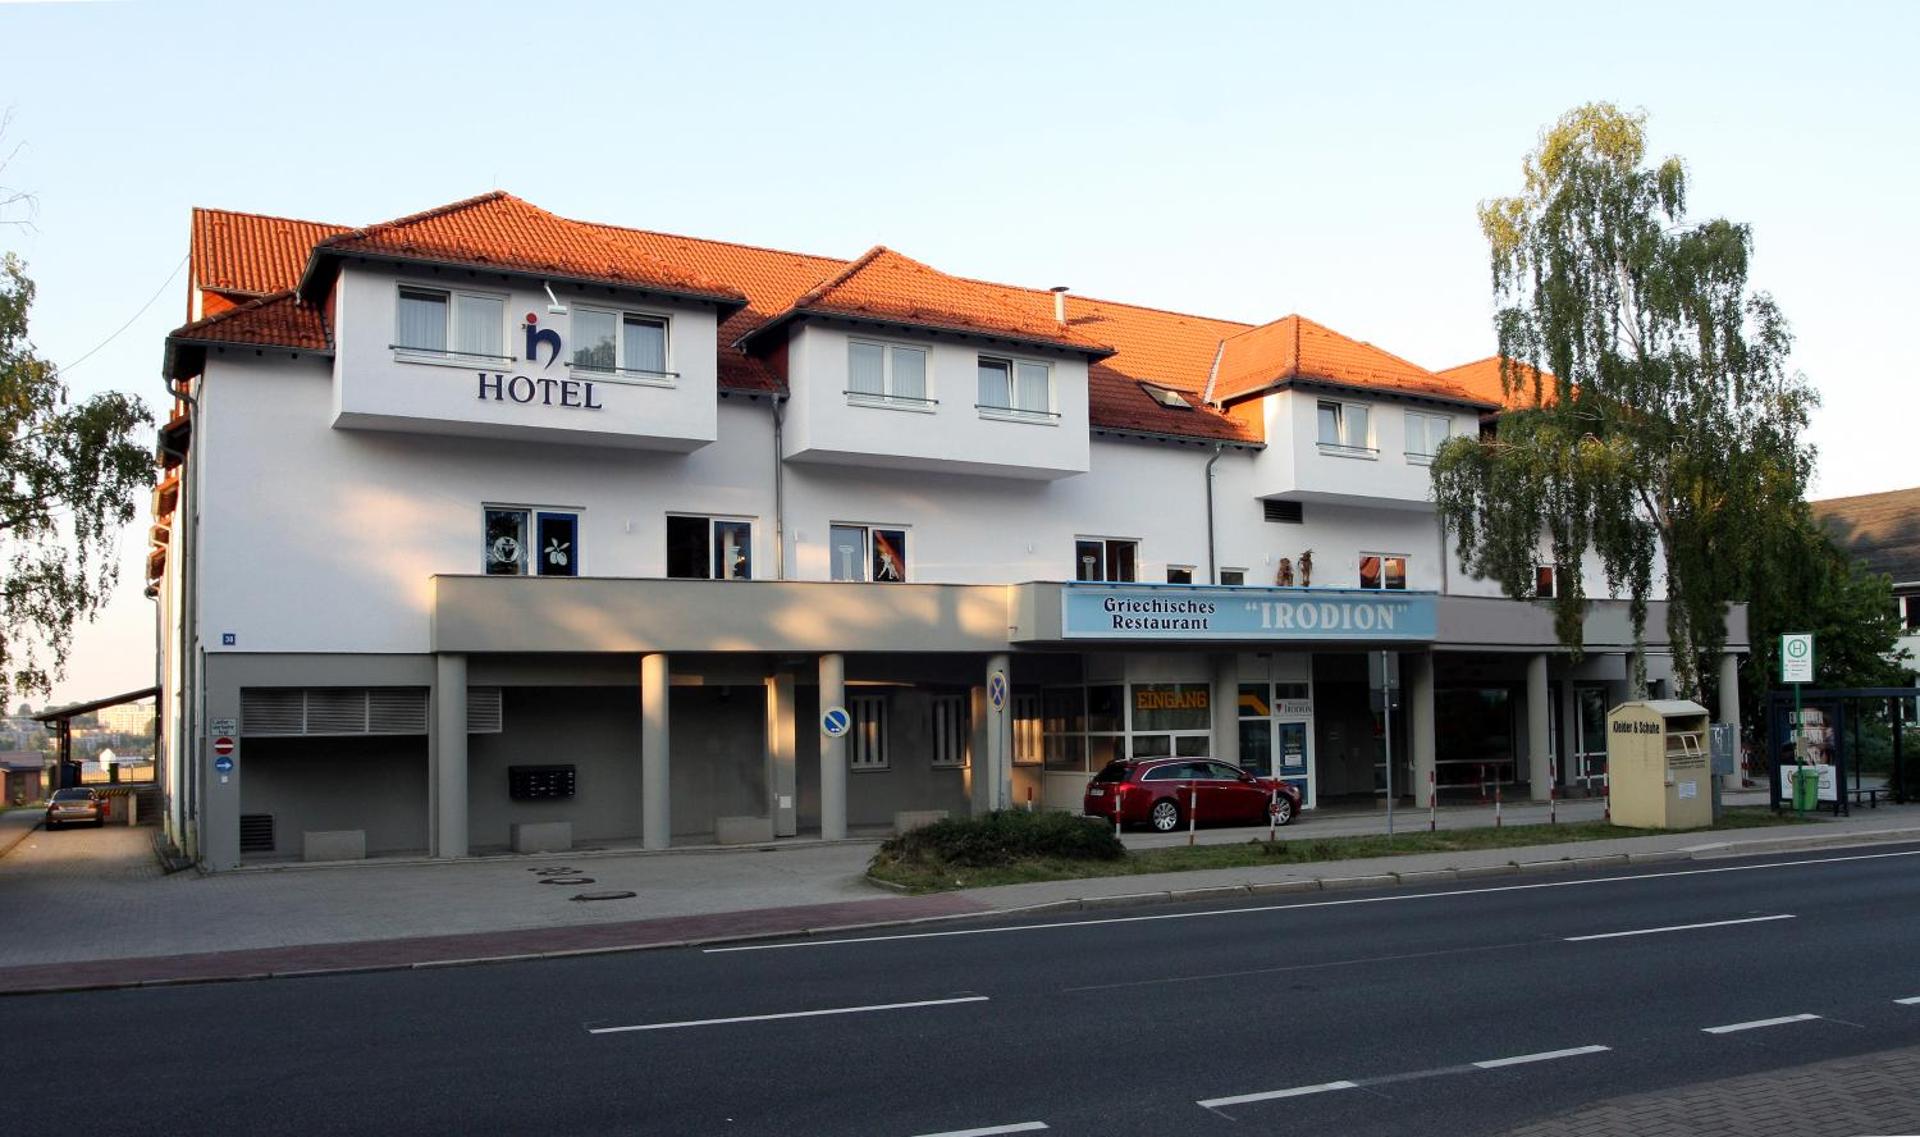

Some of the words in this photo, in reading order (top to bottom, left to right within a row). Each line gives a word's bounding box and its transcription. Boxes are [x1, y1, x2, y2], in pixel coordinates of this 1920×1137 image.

[478, 373, 603, 409] HOTEL
[1104, 597, 1216, 614] Griechisches
[1112, 615, 1208, 630] Restaurant
[1136, 691, 1207, 709] EINGANG
